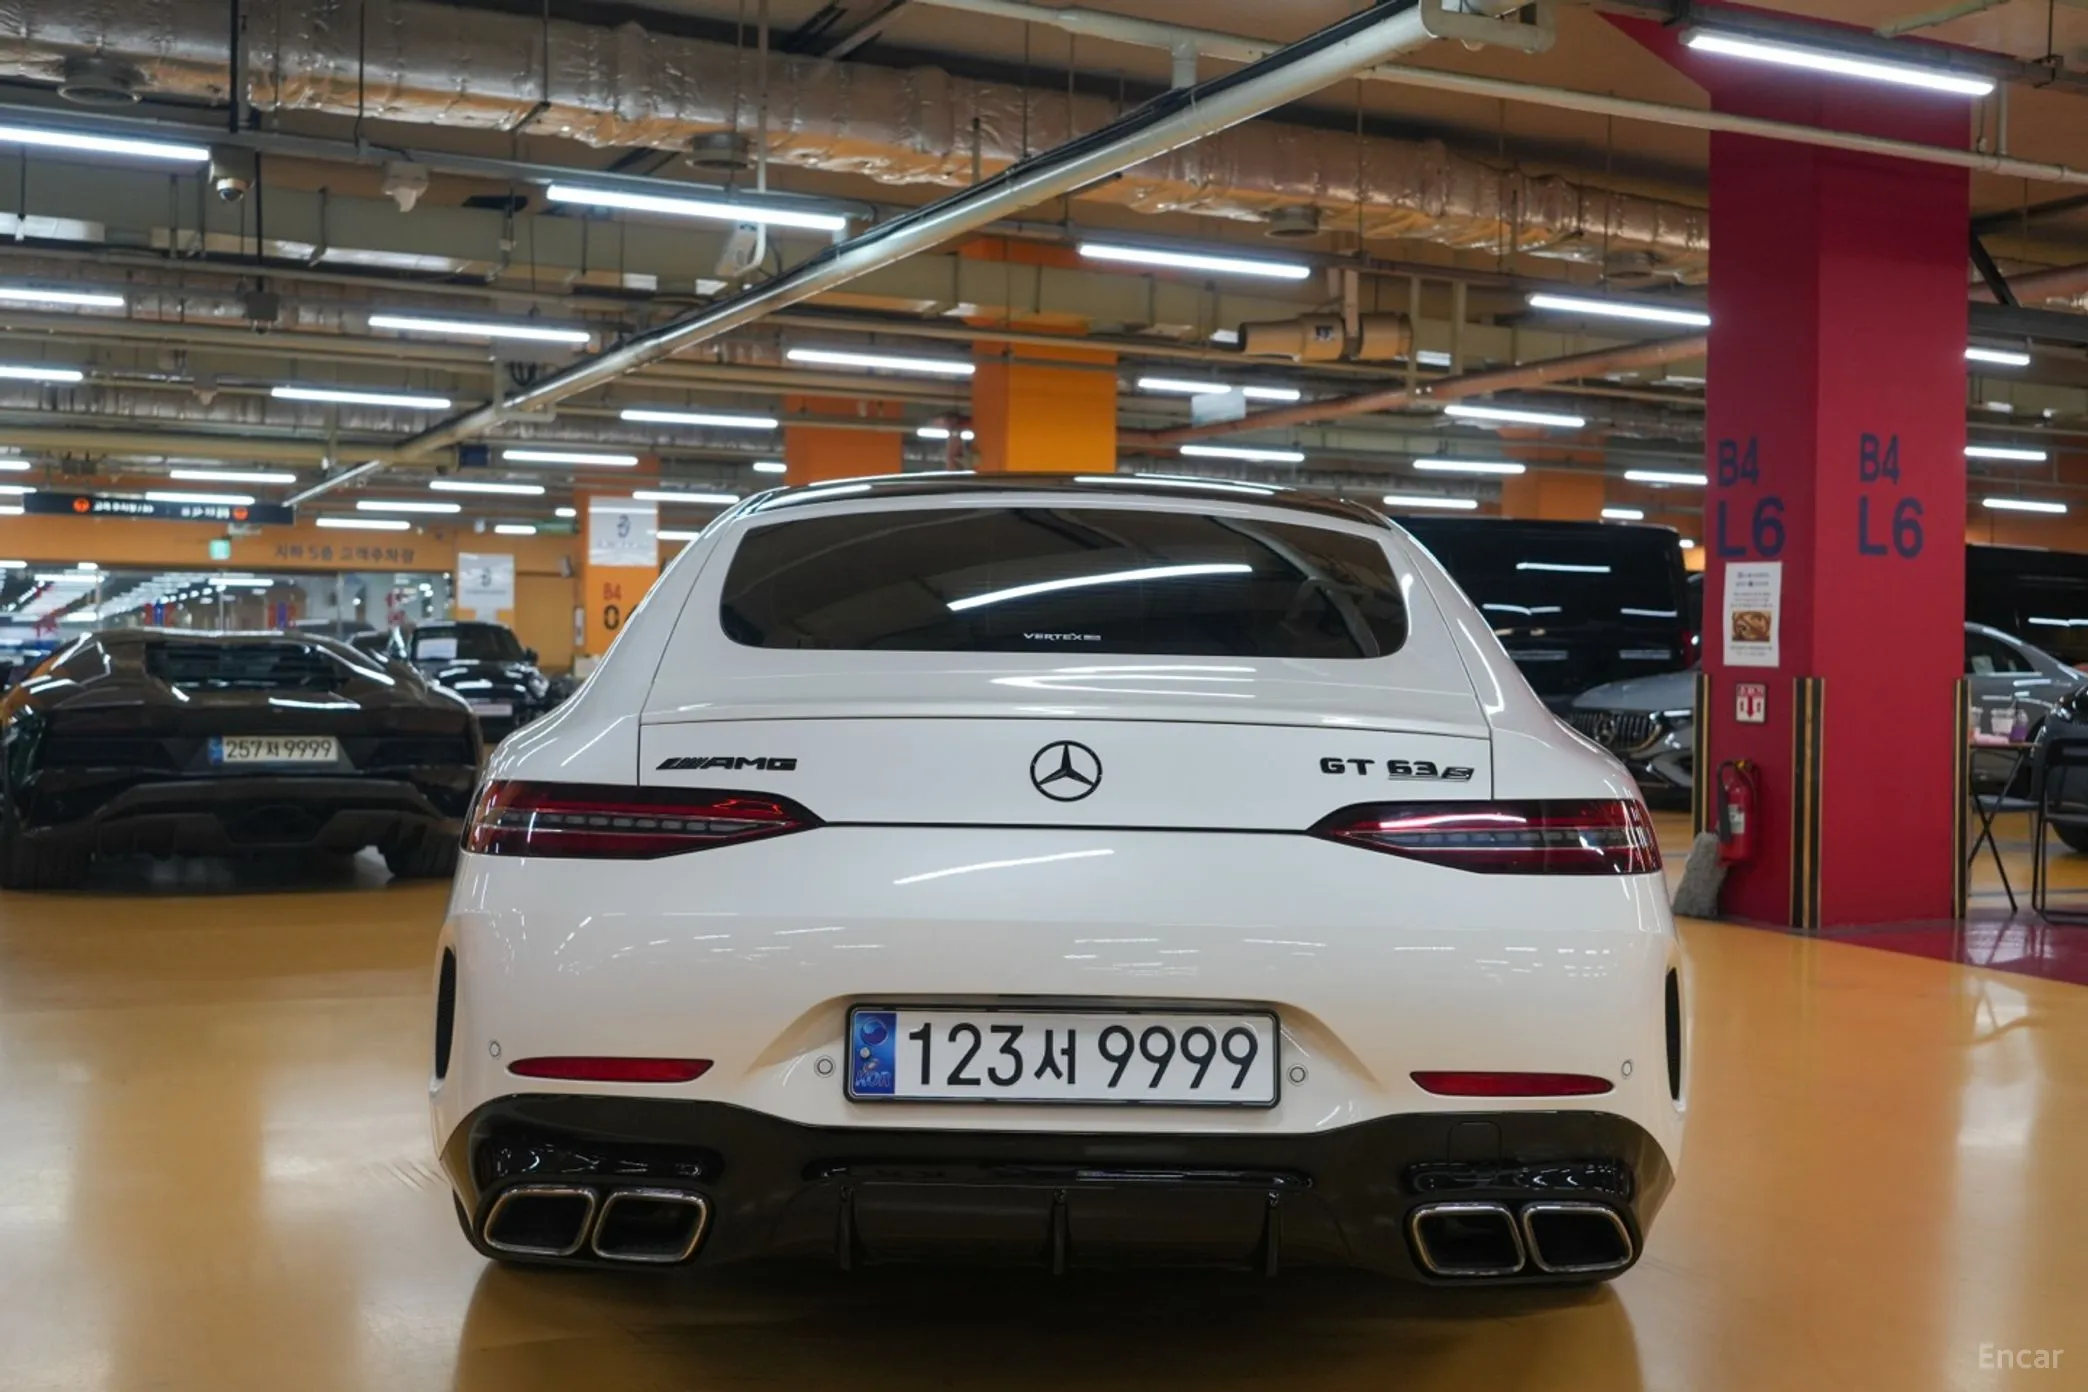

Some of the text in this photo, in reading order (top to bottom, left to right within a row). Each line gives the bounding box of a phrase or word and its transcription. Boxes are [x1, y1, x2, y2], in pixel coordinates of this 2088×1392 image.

[1718, 436, 1759, 487] B4
[1859, 433, 1899, 484] B4
[1717, 496, 1786, 557] L6
[1858, 495, 1924, 559] L6
[1023, 633, 1082, 642] VERTEX
[284, 739, 332, 758] 9999
[698, 757, 797, 771] AMG
[1320, 757, 1375, 775] GT
[909, 1022, 1258, 1090] 123서 9999
